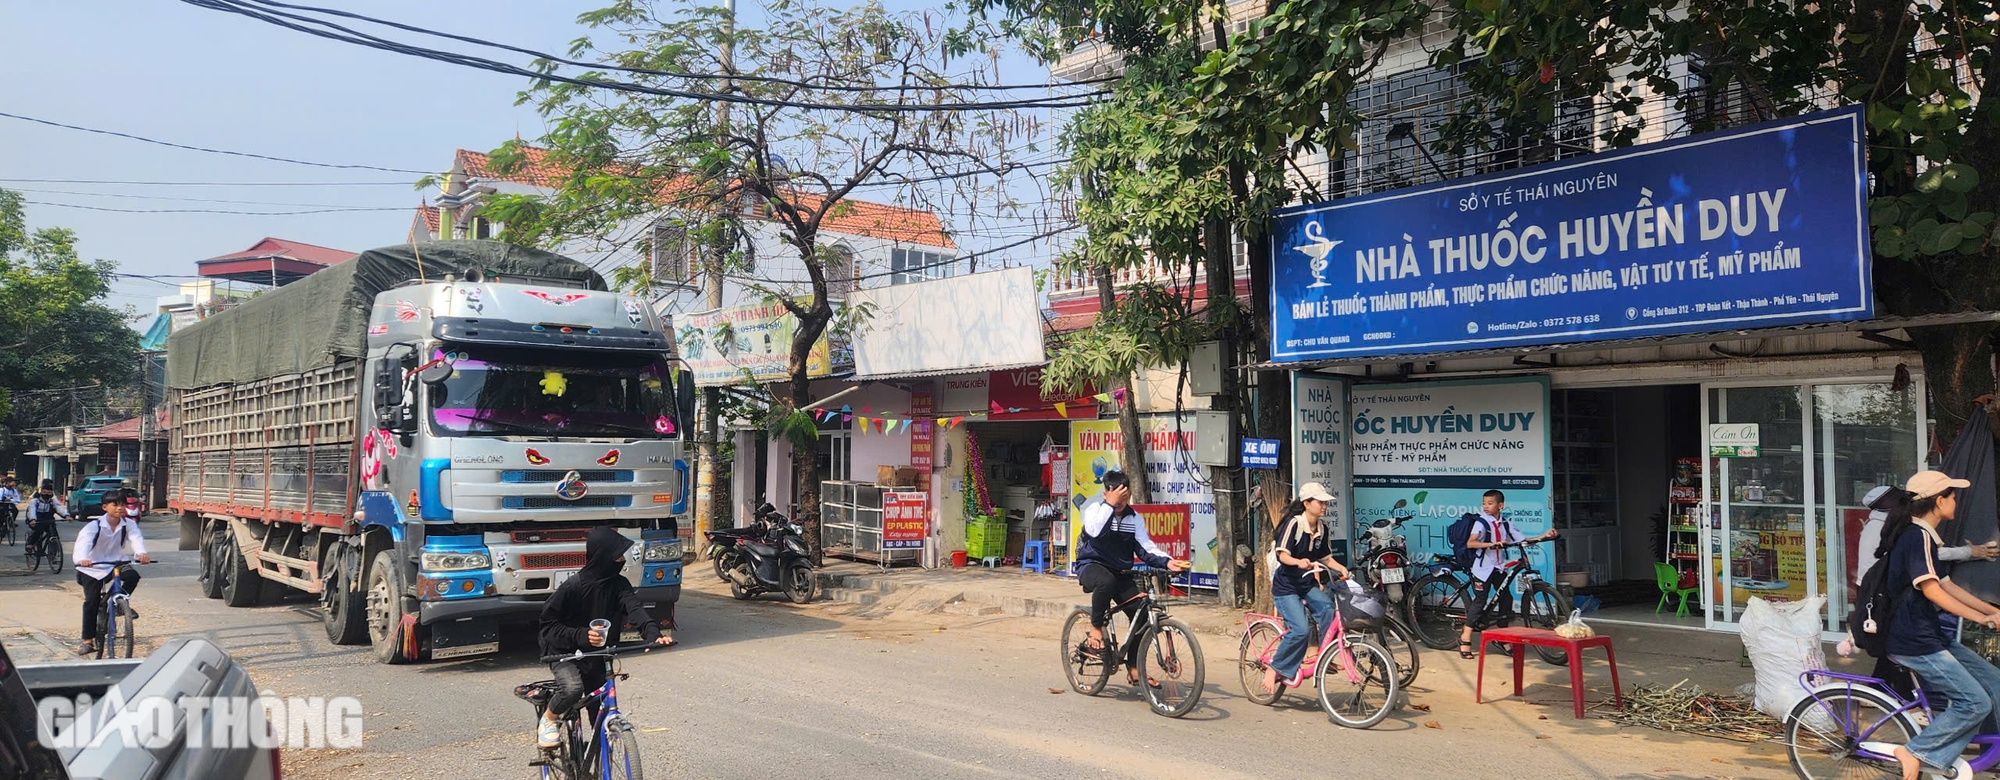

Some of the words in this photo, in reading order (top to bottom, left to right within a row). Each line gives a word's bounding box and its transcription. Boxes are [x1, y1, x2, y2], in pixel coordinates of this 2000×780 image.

[1459, 192, 1478, 212] SỞ
[1481, 195, 1490, 208] Y
[1495, 185, 1512, 206] TẾ
[1516, 182, 1549, 203] THÁI
[1553, 171, 1618, 197] NGUYÊN
[1356, 232, 1421, 283] NHÀ
[1429, 211, 1547, 275] THUỐC
[1559, 188, 1686, 260] HUYỀN
[1700, 187, 1788, 241] DUY
[1292, 300, 1313, 320] BÁN
[1316, 296, 1329, 317] LẺ
[1332, 292, 1367, 316] THUỐC
[1370, 290, 1408, 312] THÀNH
[1410, 282, 1450, 308] PHẨM,
[1452, 284, 1485, 307] THỰC
[1488, 274, 1527, 301] PHẨM
[1531, 272, 1568, 296] CHỨC
[1571, 268, 1617, 292] NĂNG,
[1620, 264, 1648, 290] VẬT
[1652, 259, 1675, 281] TƯ
[1676, 260, 1686, 281] Y
[1690, 251, 1713, 280] TẾ,
[1718, 248, 1744, 276] MỸ
[1749, 240, 1801, 272] PHẨM
[1678, 305, 1689, 314] 312
[1802, 293, 1815, 302] Thái
[1816, 292, 1839, 303] Nguyên
[734, 306, 769, 322] THANH
[1488, 320, 1538, 331] Hotline/Zalo
[1543, 317, 1564, 327] 0372
[1566, 315, 1582, 325] 578
[1583, 314, 1600, 323] 638
[1330, 335, 1350, 344] QUANG
[946, 380, 970, 389] TRUNG
[971, 378, 987, 388] KIÊN
[1308, 386, 1332, 403] NHÀ
[1367, 394, 1376, 403] TẾ
[1378, 394, 1396, 403] THÁI
[1398, 394, 1431, 403] NGUYÊN
[1301, 405, 1340, 424] THUỐC
[1391, 405, 1473, 434] HUYỀN
[1480, 411, 1535, 432] DUY
[1080, 428, 1100, 450] VĂN
[1301, 424, 1340, 444] HUYỀN
[1244, 442, 1258, 453] XE
[1260, 440, 1276, 454] ÔM
[1371, 438, 1397, 451] PHẨM
[1400, 441, 1426, 453] THỰC
[1429, 437, 1457, 450] PHẨM
[1460, 438, 1488, 450] CHỨC
[1493, 438, 1524, 449] NĂNG
[1311, 452, 1335, 464] DUY
[1358, 454, 1370, 462] TƯ
[1381, 451, 1393, 462] TẾ
[1402, 452, 1416, 462] MỸ
[1418, 449, 1447, 462] PHẨM
[1156, 460, 1171, 473] MÁY
[1450, 465, 1472, 473] THUỐC
[1167, 482, 1184, 497] CHỤP
[1172, 538, 1186, 560] TẬP
